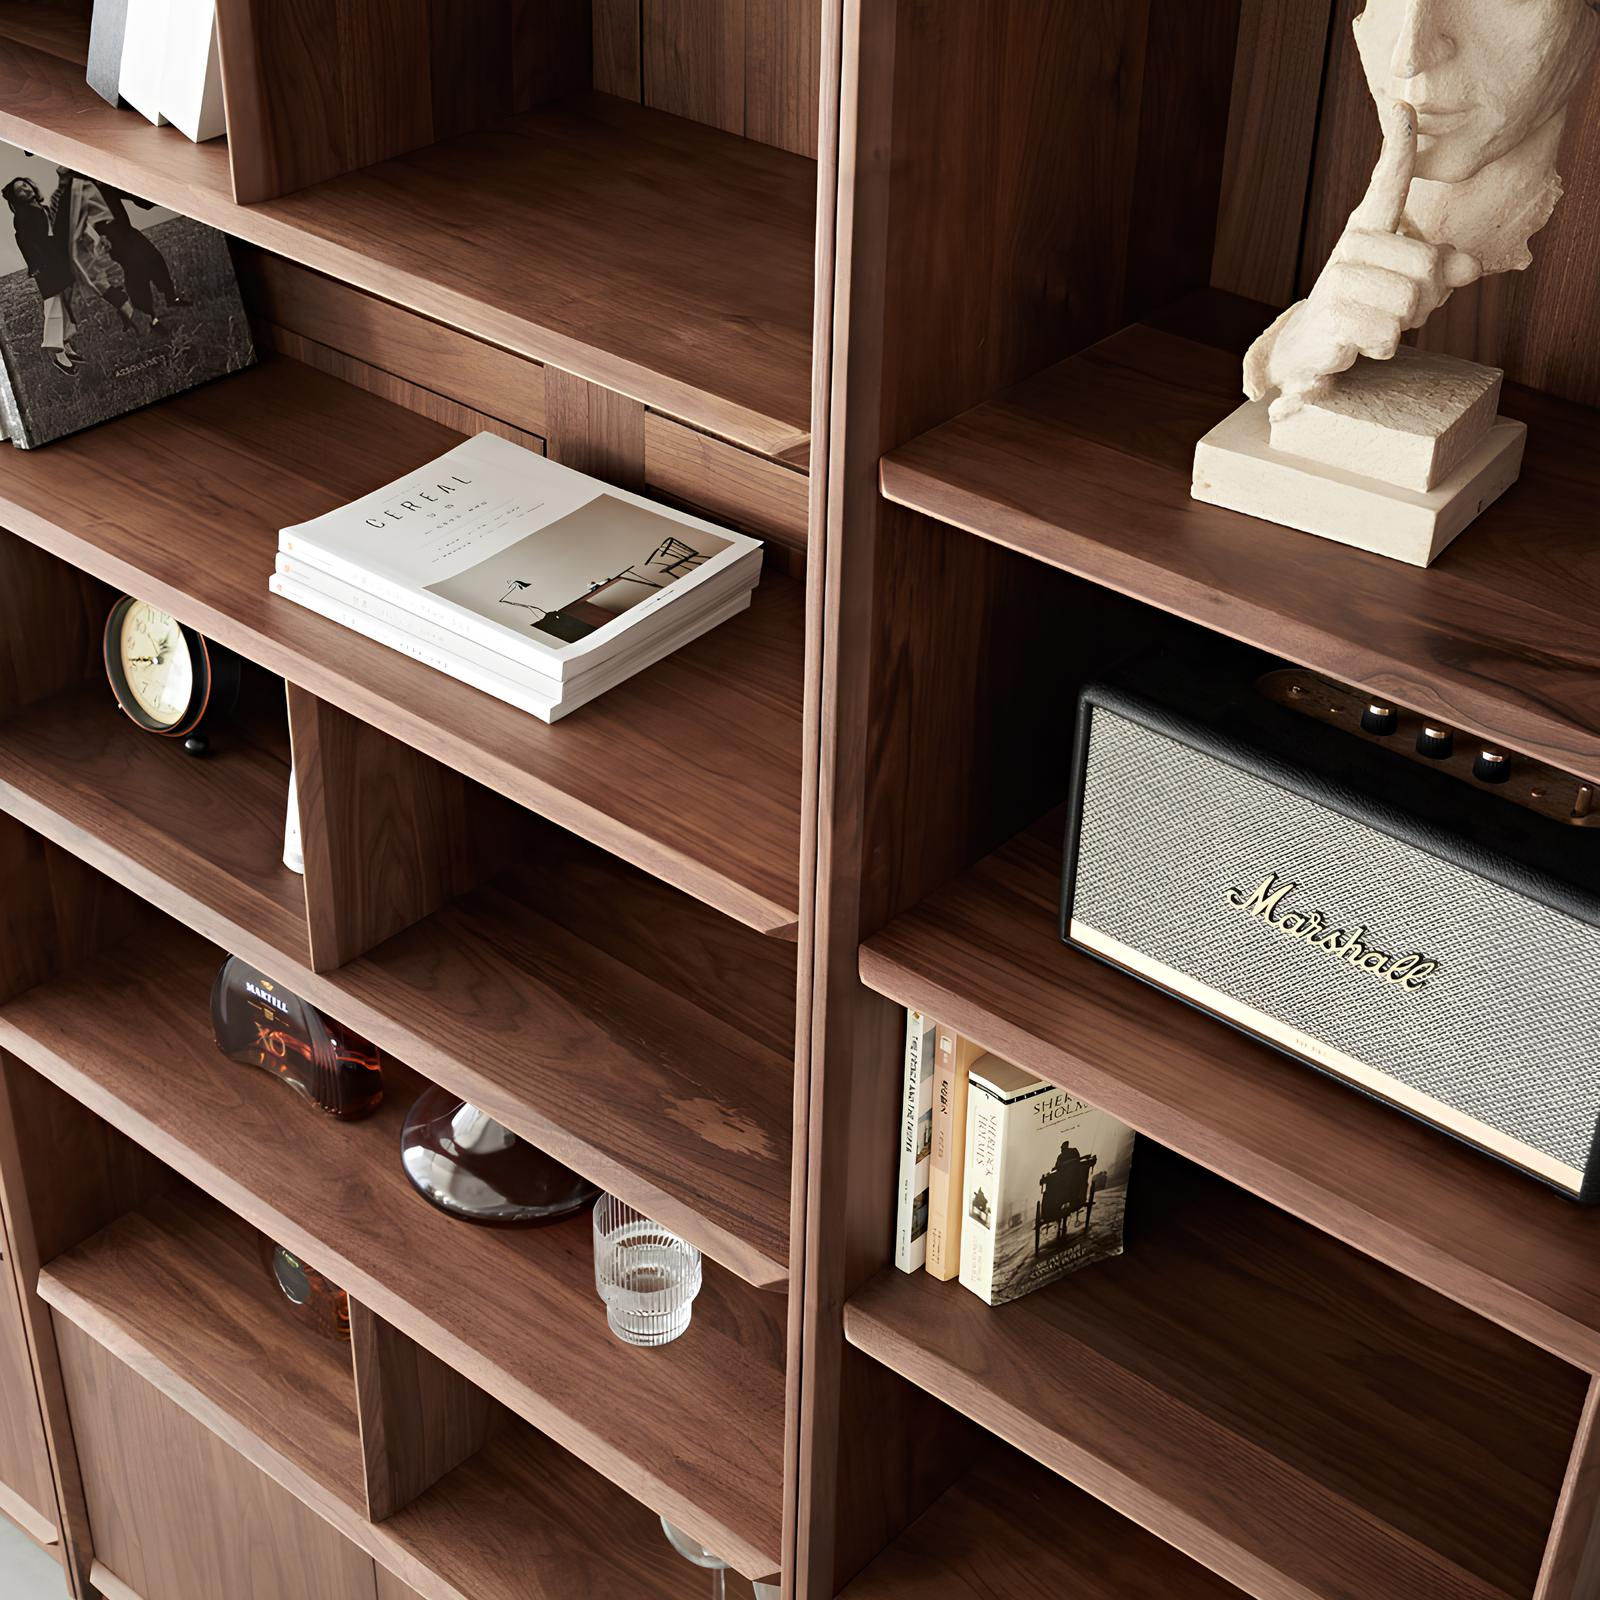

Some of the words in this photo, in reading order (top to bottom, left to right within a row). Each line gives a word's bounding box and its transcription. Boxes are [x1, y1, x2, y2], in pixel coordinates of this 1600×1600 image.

[365, 475, 473, 529] CEREAL
[1224, 871, 1438, 991] Marshall
[245, 981, 289, 1014] MARTELL
[254, 1021, 286, 1057] XO
